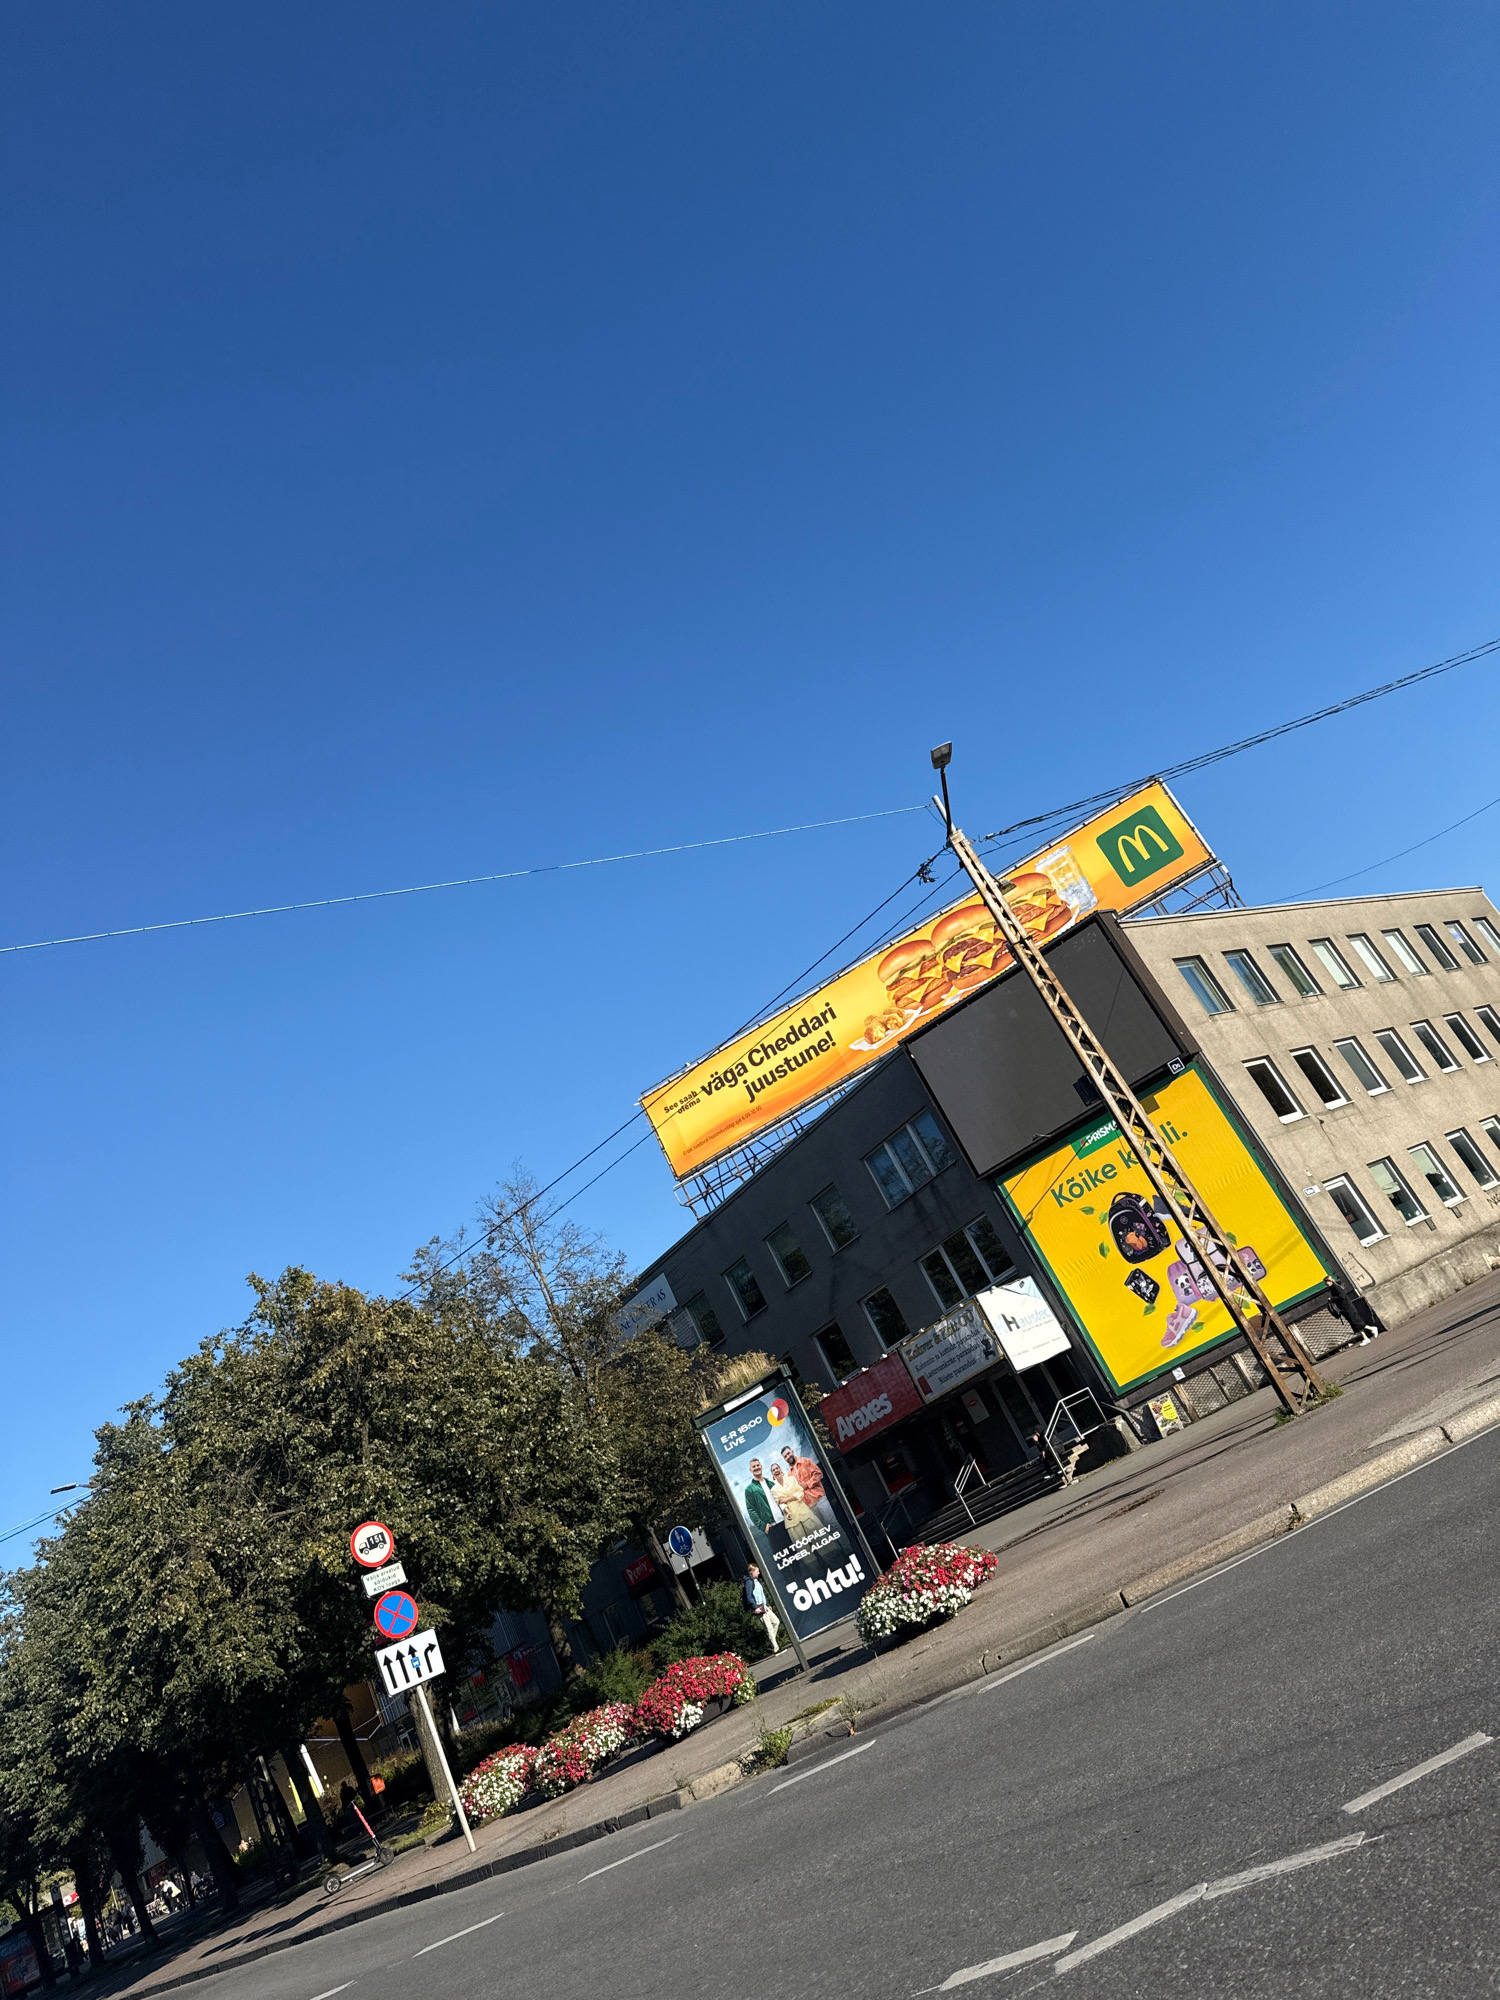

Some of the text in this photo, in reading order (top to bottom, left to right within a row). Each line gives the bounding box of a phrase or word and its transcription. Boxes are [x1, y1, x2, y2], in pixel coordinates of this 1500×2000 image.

[700, 1002, 838, 1096] väga Cheddari
[744, 1030, 837, 1103] juustune!
[663, 1090, 697, 1114] See saab
[1050, 1121, 1188, 1208] Kõike kli.
[721, 1416, 763, 1444] E-R 18:00
[836, 1393, 892, 1442] Araxes
[724, 1435, 746, 1452] LIVE
[369, 1533, 384, 1545] 15t
[773, 1549, 789, 1561] KUI
[777, 1531, 841, 1570] LÕPEB, ALGAB
